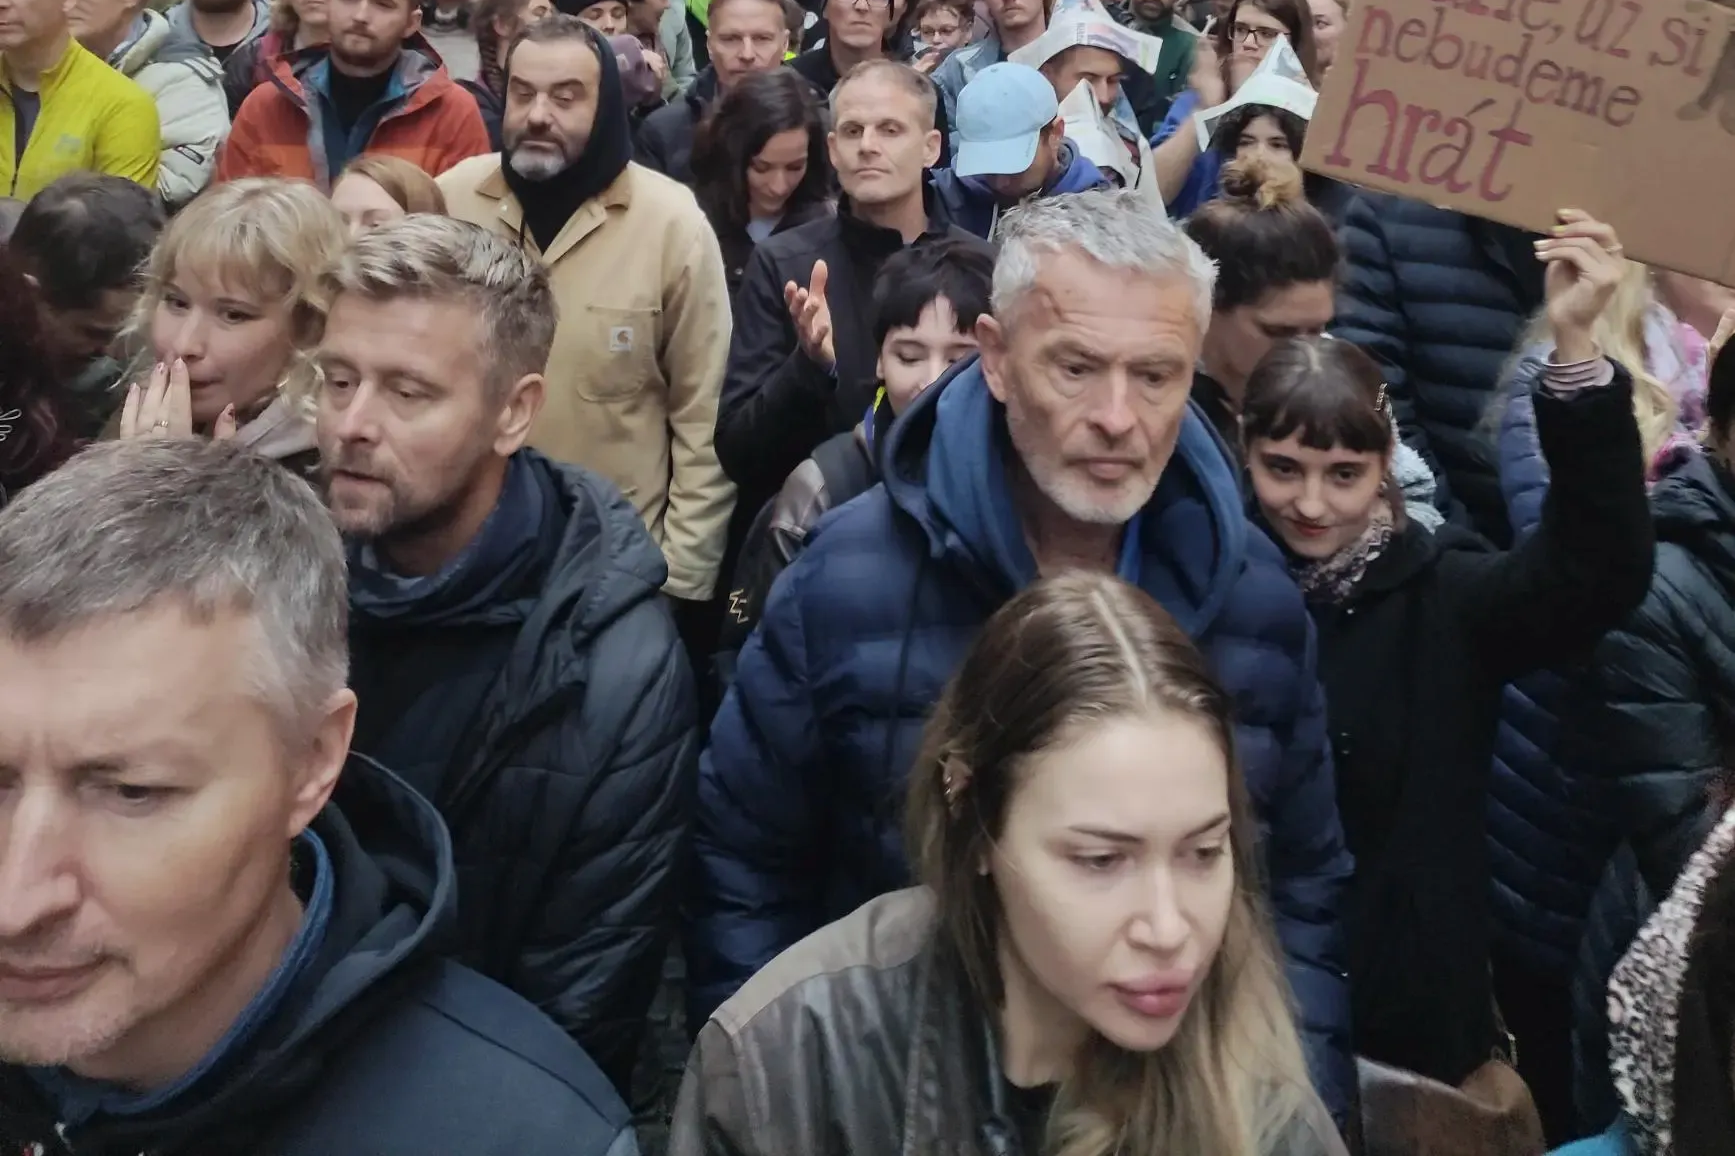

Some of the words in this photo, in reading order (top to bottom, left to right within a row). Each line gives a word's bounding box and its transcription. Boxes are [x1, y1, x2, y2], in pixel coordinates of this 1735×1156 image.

[1354, 4, 1643, 128] nebudeme
[1647, 15, 1713, 78] si
[1323, 57, 1533, 203] hrát
